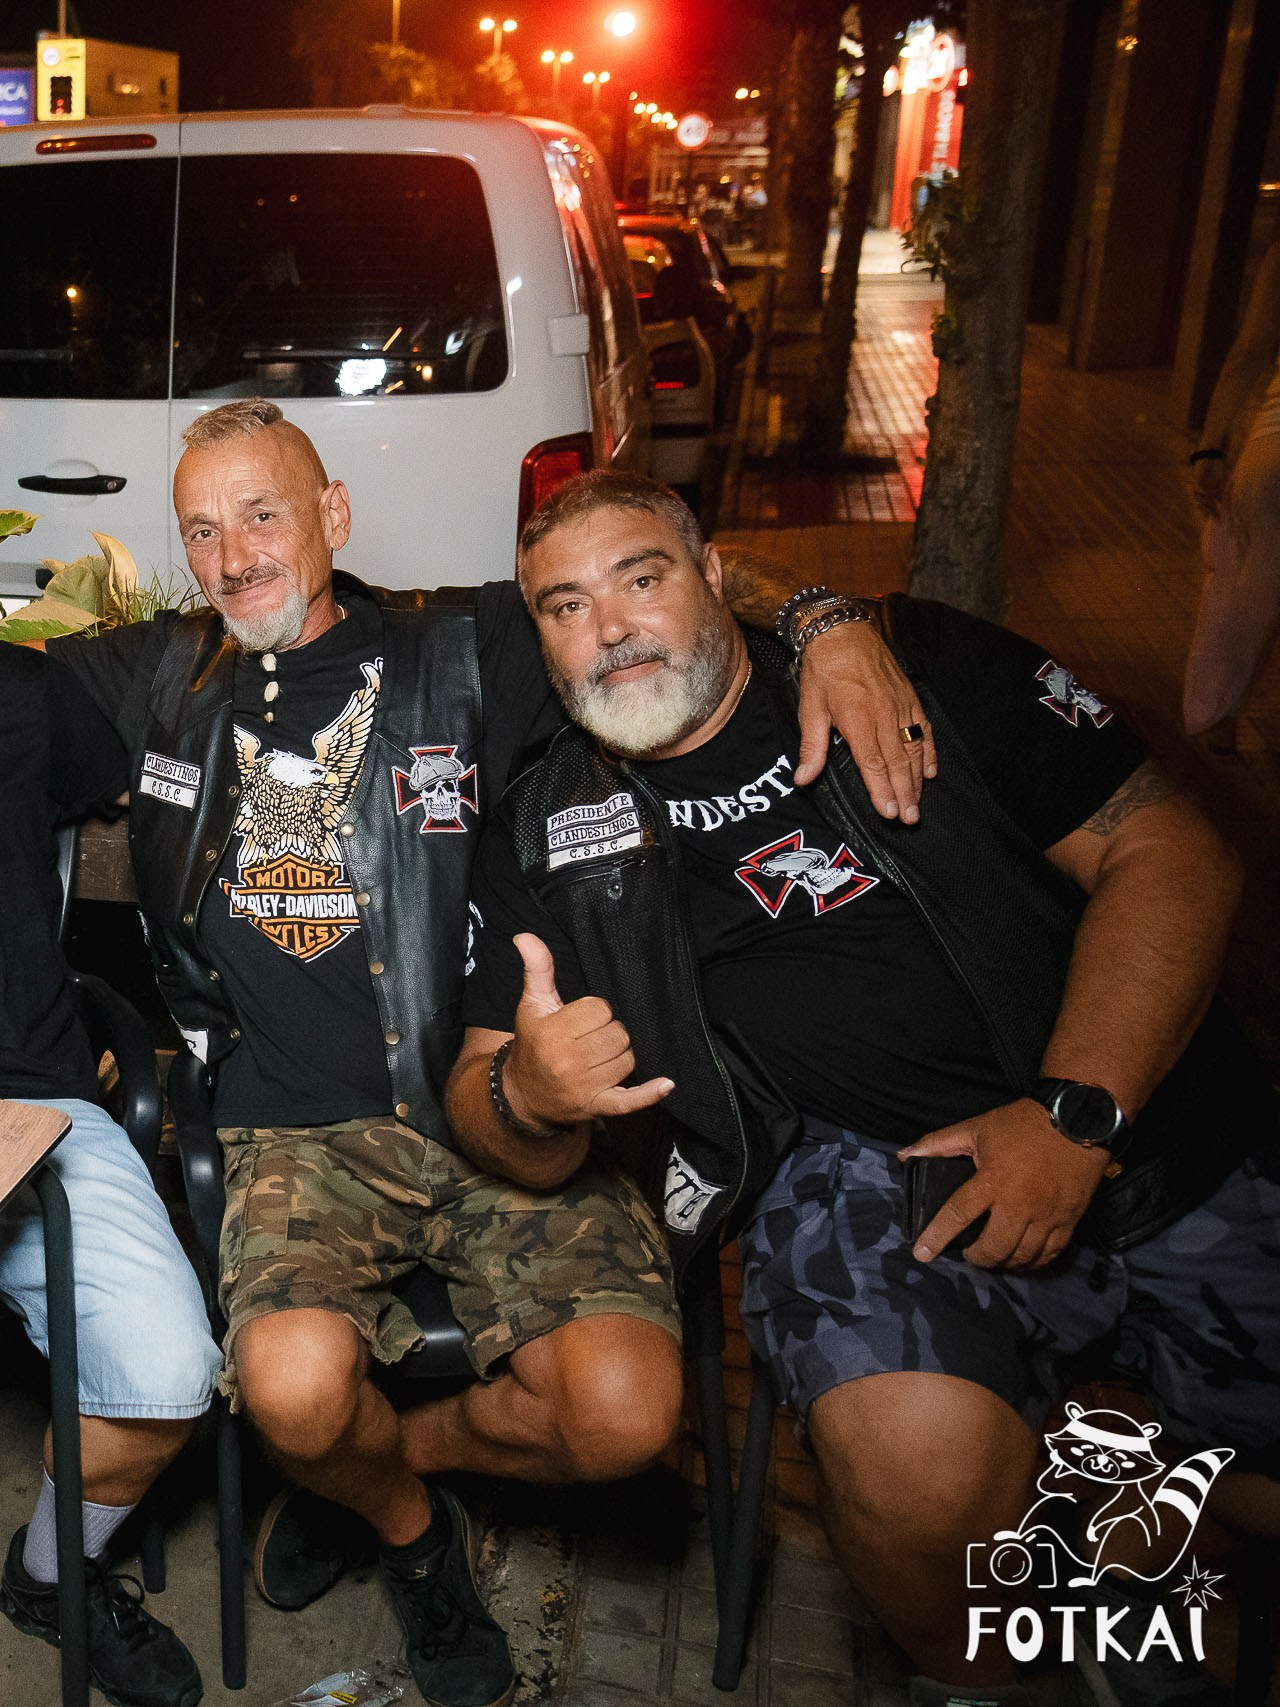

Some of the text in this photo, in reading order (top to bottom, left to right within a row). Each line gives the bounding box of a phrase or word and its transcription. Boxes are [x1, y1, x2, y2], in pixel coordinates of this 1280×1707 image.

[146, 755, 199, 782] CLANDESTINOS
[665, 754, 794, 832] NDEST
[550, 795, 630, 829] PRESIDENTE
[550, 813, 635, 847] CLANDESTINOS
[256, 861, 326, 888] MOTOR
[266, 923, 329, 955] YCLES
